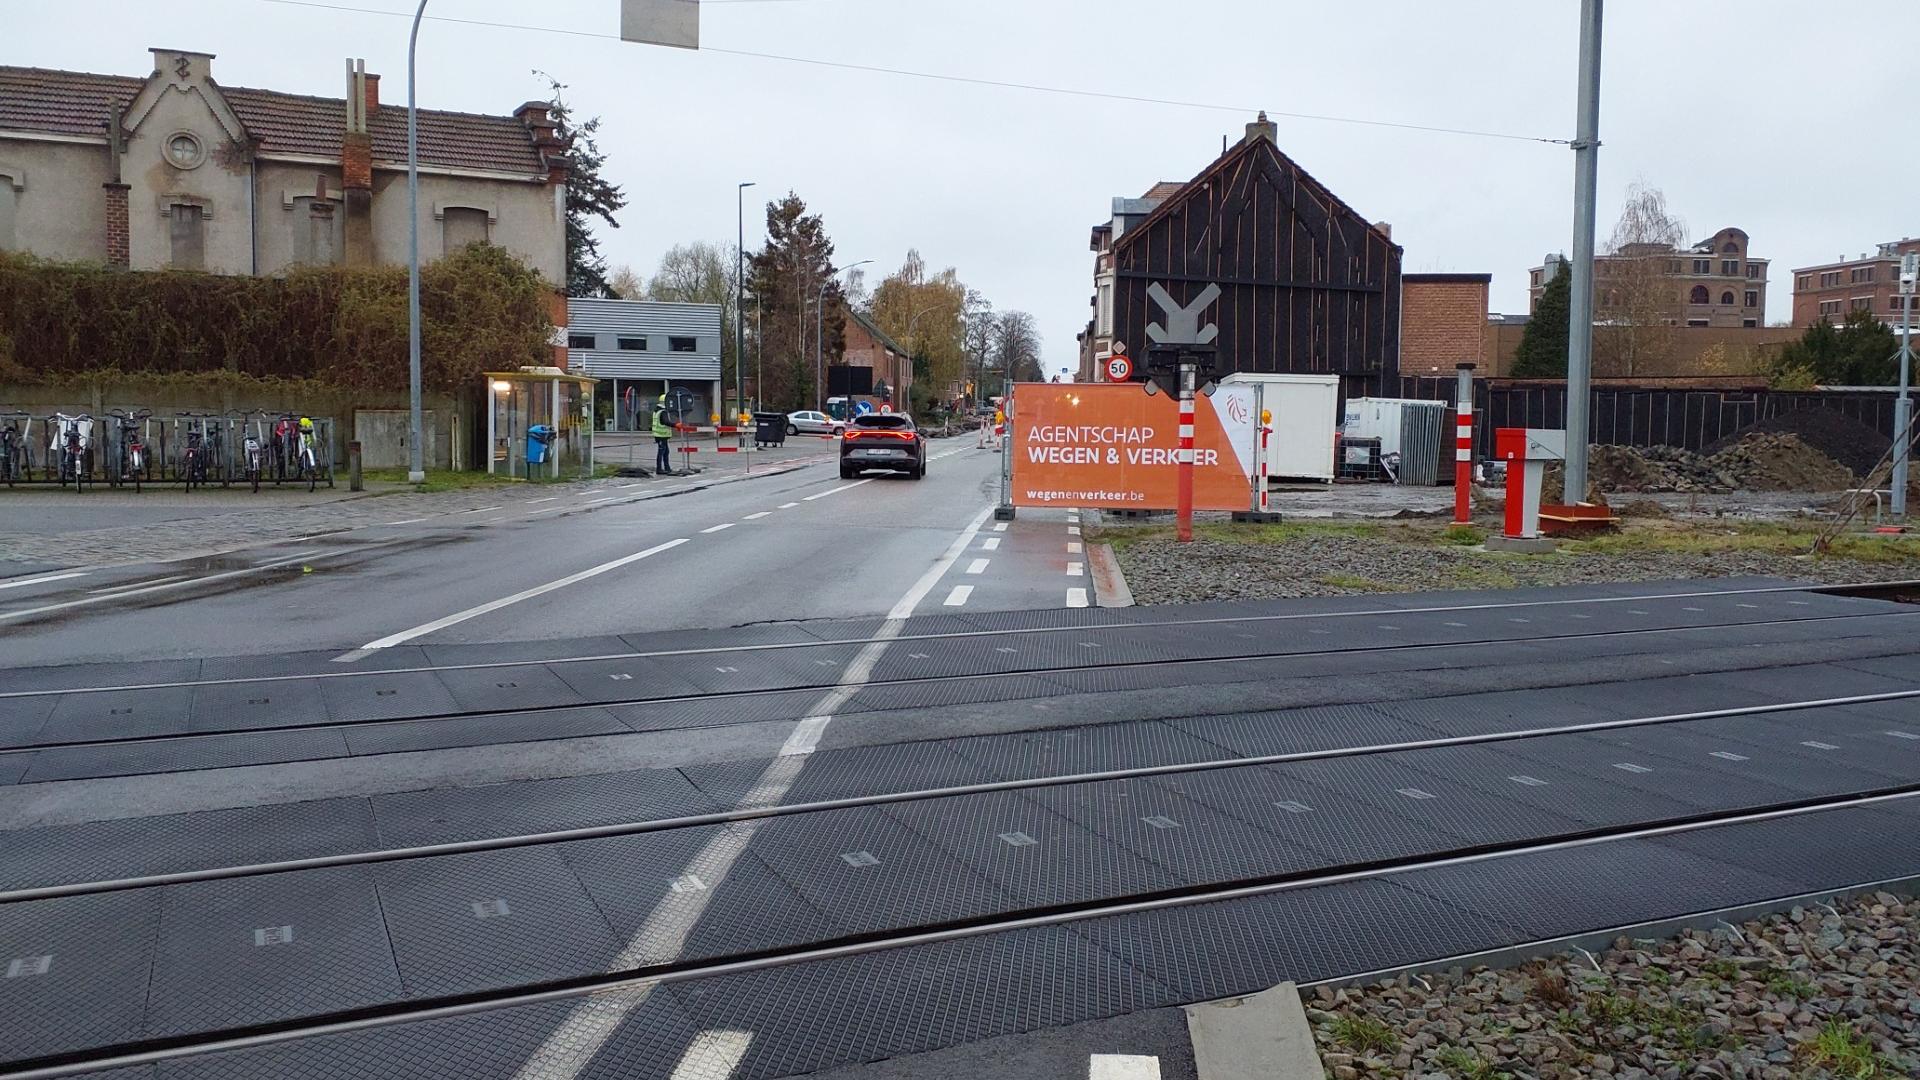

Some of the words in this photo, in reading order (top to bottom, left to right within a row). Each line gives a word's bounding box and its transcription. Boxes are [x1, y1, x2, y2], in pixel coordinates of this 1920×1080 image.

[1111, 363, 1126, 374] 50
[1028, 426, 1154, 443] AGENTSCHAP
[1027, 447, 1099, 464] WEGEN
[1106, 447, 1119, 464] &
[1126, 448, 1219, 466] VERKER
[1027, 490, 1144, 501] wegenenverkeer.be
